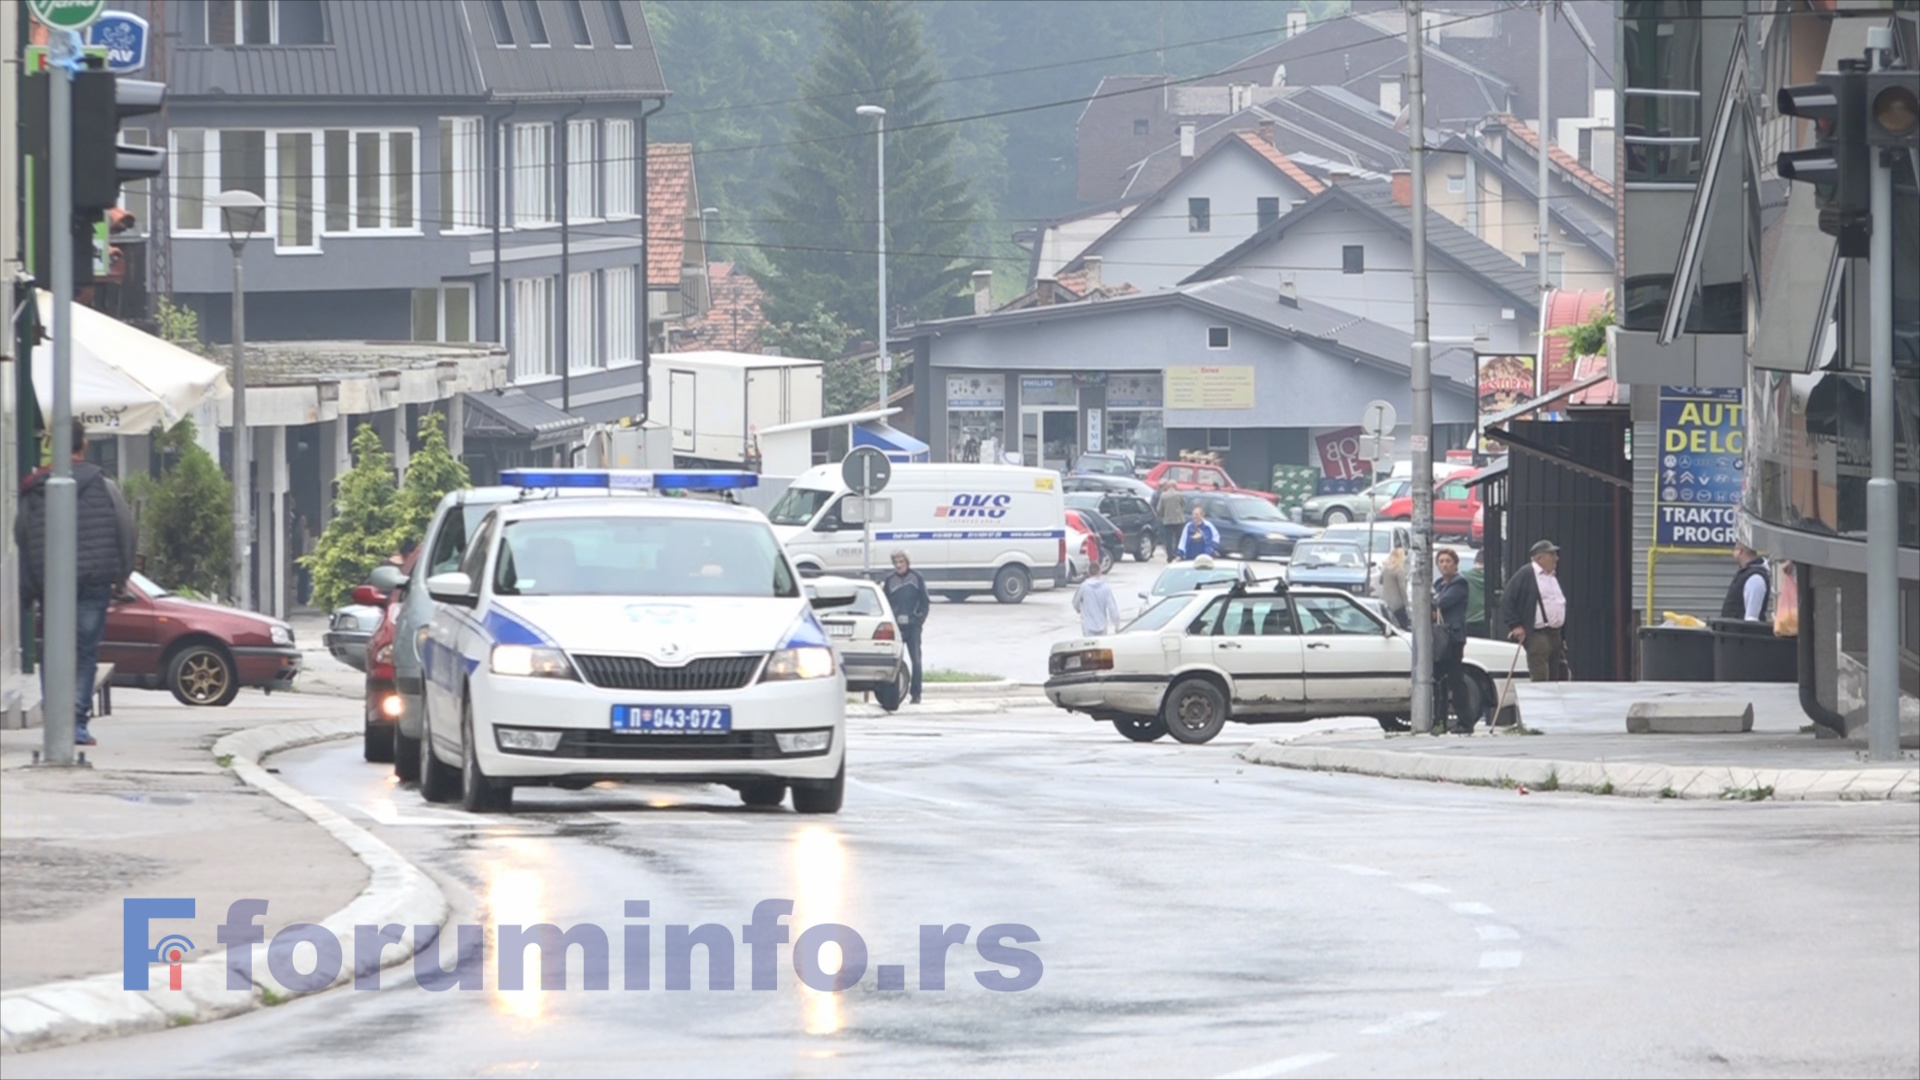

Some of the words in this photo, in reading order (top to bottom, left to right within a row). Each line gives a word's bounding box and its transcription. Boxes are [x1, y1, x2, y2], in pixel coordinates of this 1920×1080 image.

[1023, 379, 1054, 388] PHILIPS
[1678, 402, 1744, 427] AUT
[1090, 414, 1099, 449] VEMA
[1665, 428, 1744, 454] DELO
[947, 493, 1012, 519] AKS
[1662, 507, 1737, 524] TRAKTO
[1673, 526, 1737, 543] PROGR
[629, 708, 641, 728] П
[653, 708, 723, 729] 043-072
